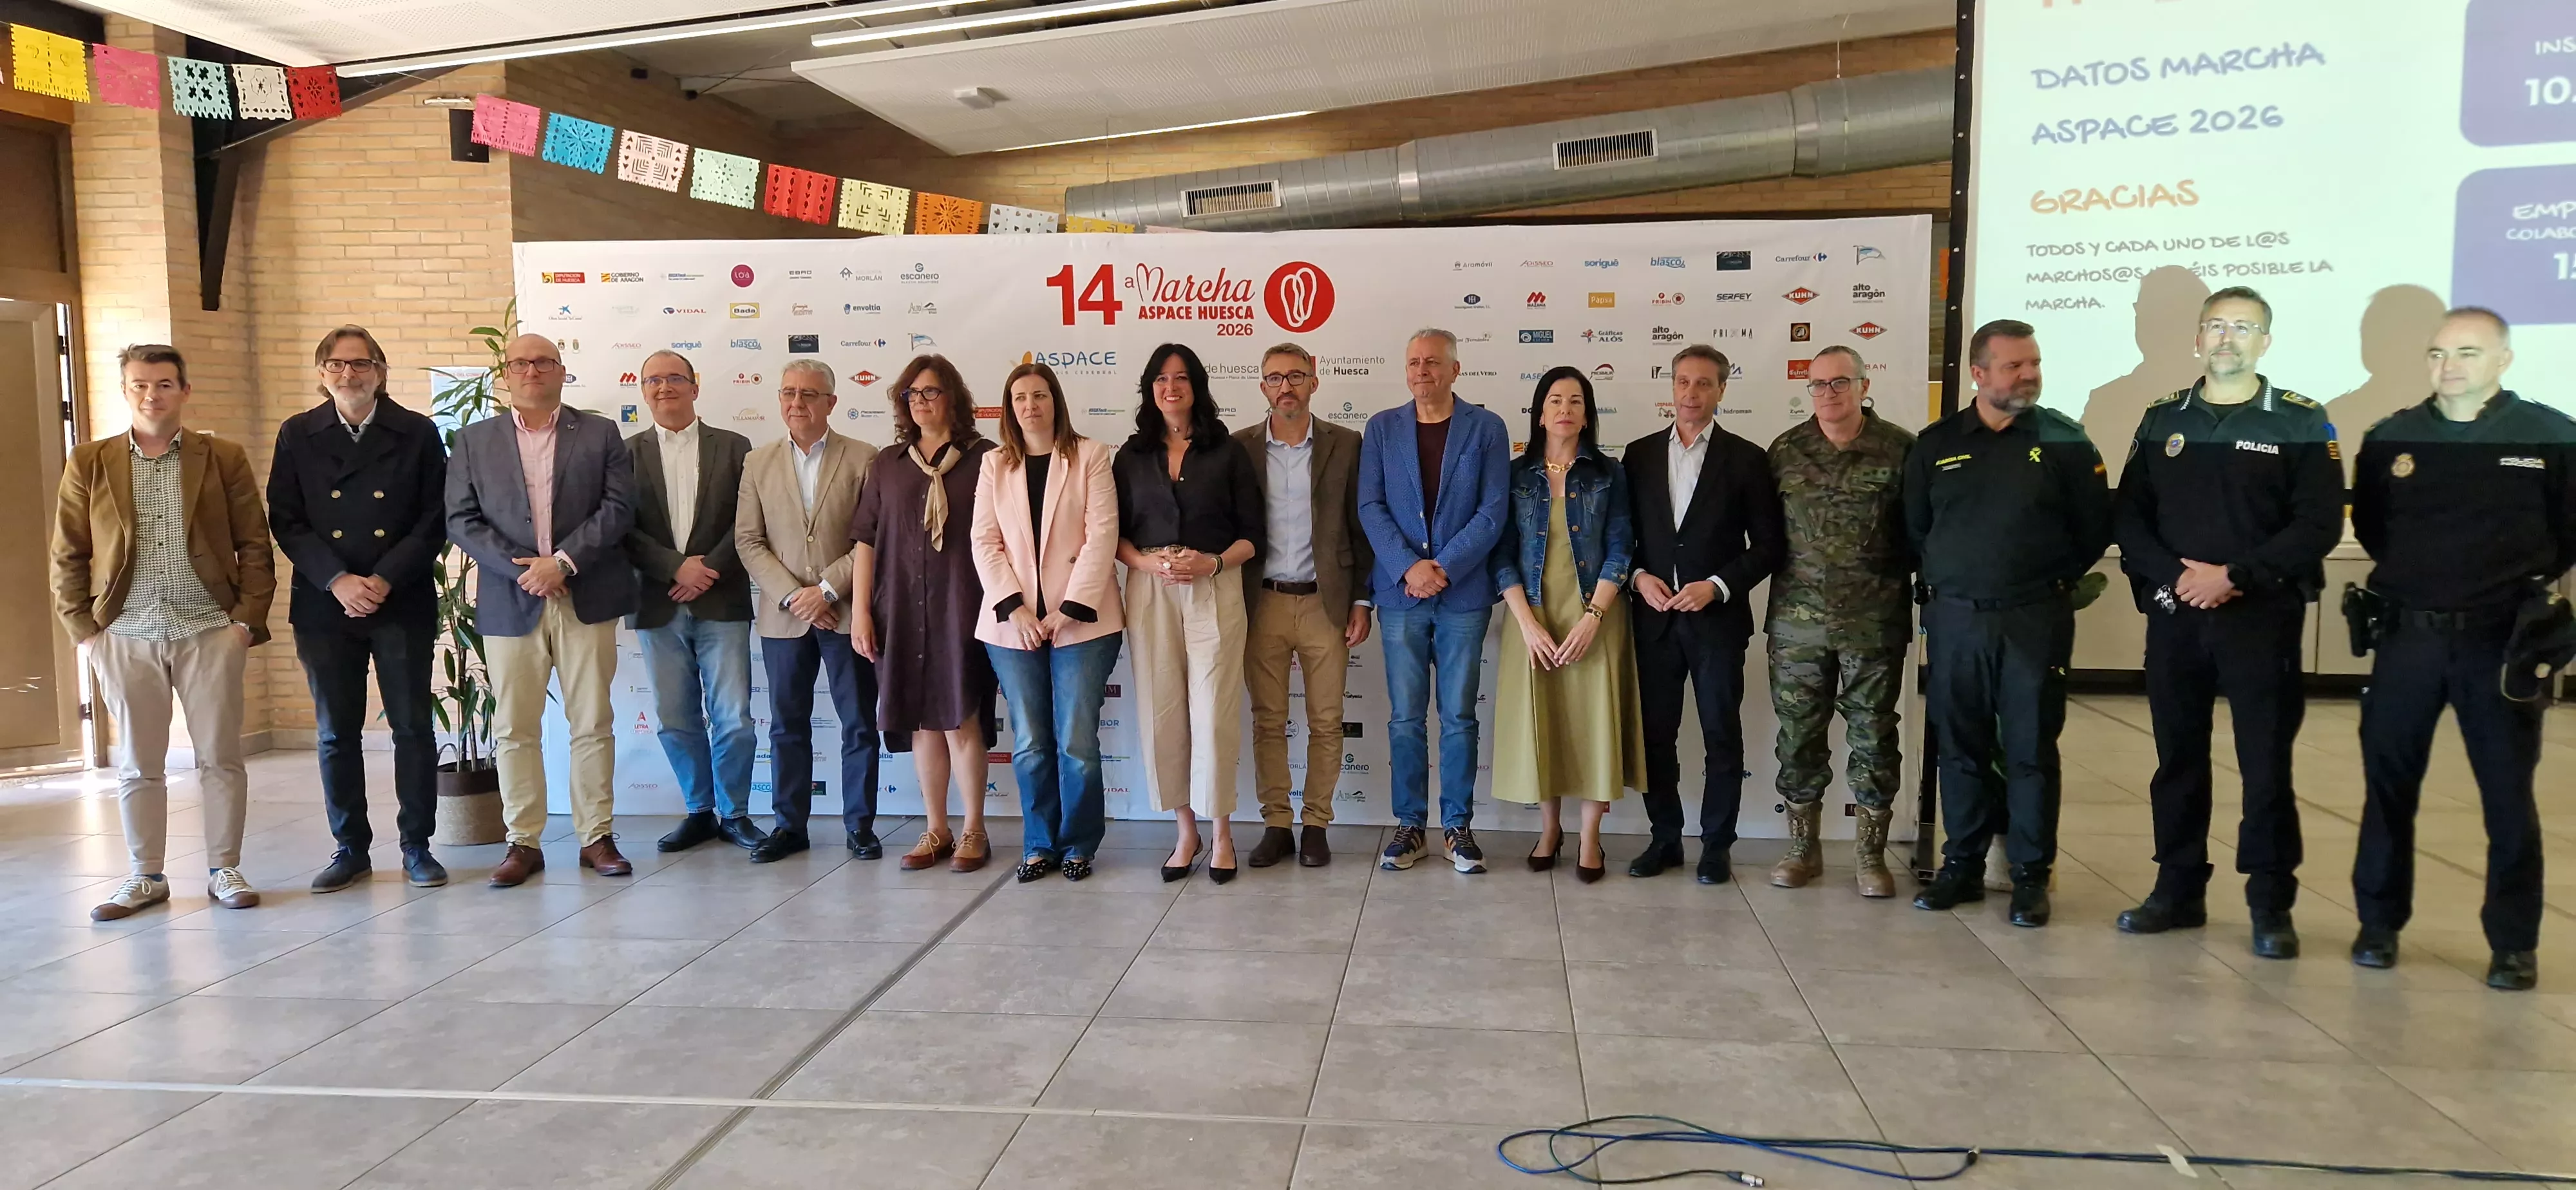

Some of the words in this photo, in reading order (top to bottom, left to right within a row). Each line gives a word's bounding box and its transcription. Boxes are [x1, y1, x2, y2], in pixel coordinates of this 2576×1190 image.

[2031, 57, 2151, 90] DATOS
[2159, 41, 2327, 80] MARCHA
[2031, 113, 2180, 146] ASPACE
[2188, 104, 2285, 135] 2026
[2030, 178, 2200, 215] GRACIAS
[2025, 241, 2086, 258] TODOS
[2088, 240, 2101, 258] Y
[2105, 240, 2159, 254] CADA
[2162, 237, 2206, 252] UNO
[2209, 235, 2242, 249] DE
[2246, 231, 2291, 249] L@S
[1775, 254, 1810, 263] Carrefour
[2222, 261, 2306, 278] POSIBLE
[2308, 258, 2334, 274] LA
[900, 272, 940, 280] escanero
[1135, 262, 1256, 303] Marcha
[1852, 283, 1871, 291] alto
[1137, 305, 1193, 320] ASPACE
[1197, 305, 1255, 320] HUESCA
[1216, 323, 1254, 337] 2026
[1652, 325, 1670, 334] alto
[840, 338, 871, 347] Carrefour
[1035, 351, 1117, 369] ASPACE
[1320, 355, 1385, 365] Ayuntamiento
[1220, 363, 1260, 373] huesca
[1320, 367, 1331, 375] de
[1333, 366, 1370, 375] Huesca
[2234, 440, 2280, 455] POLICIA
